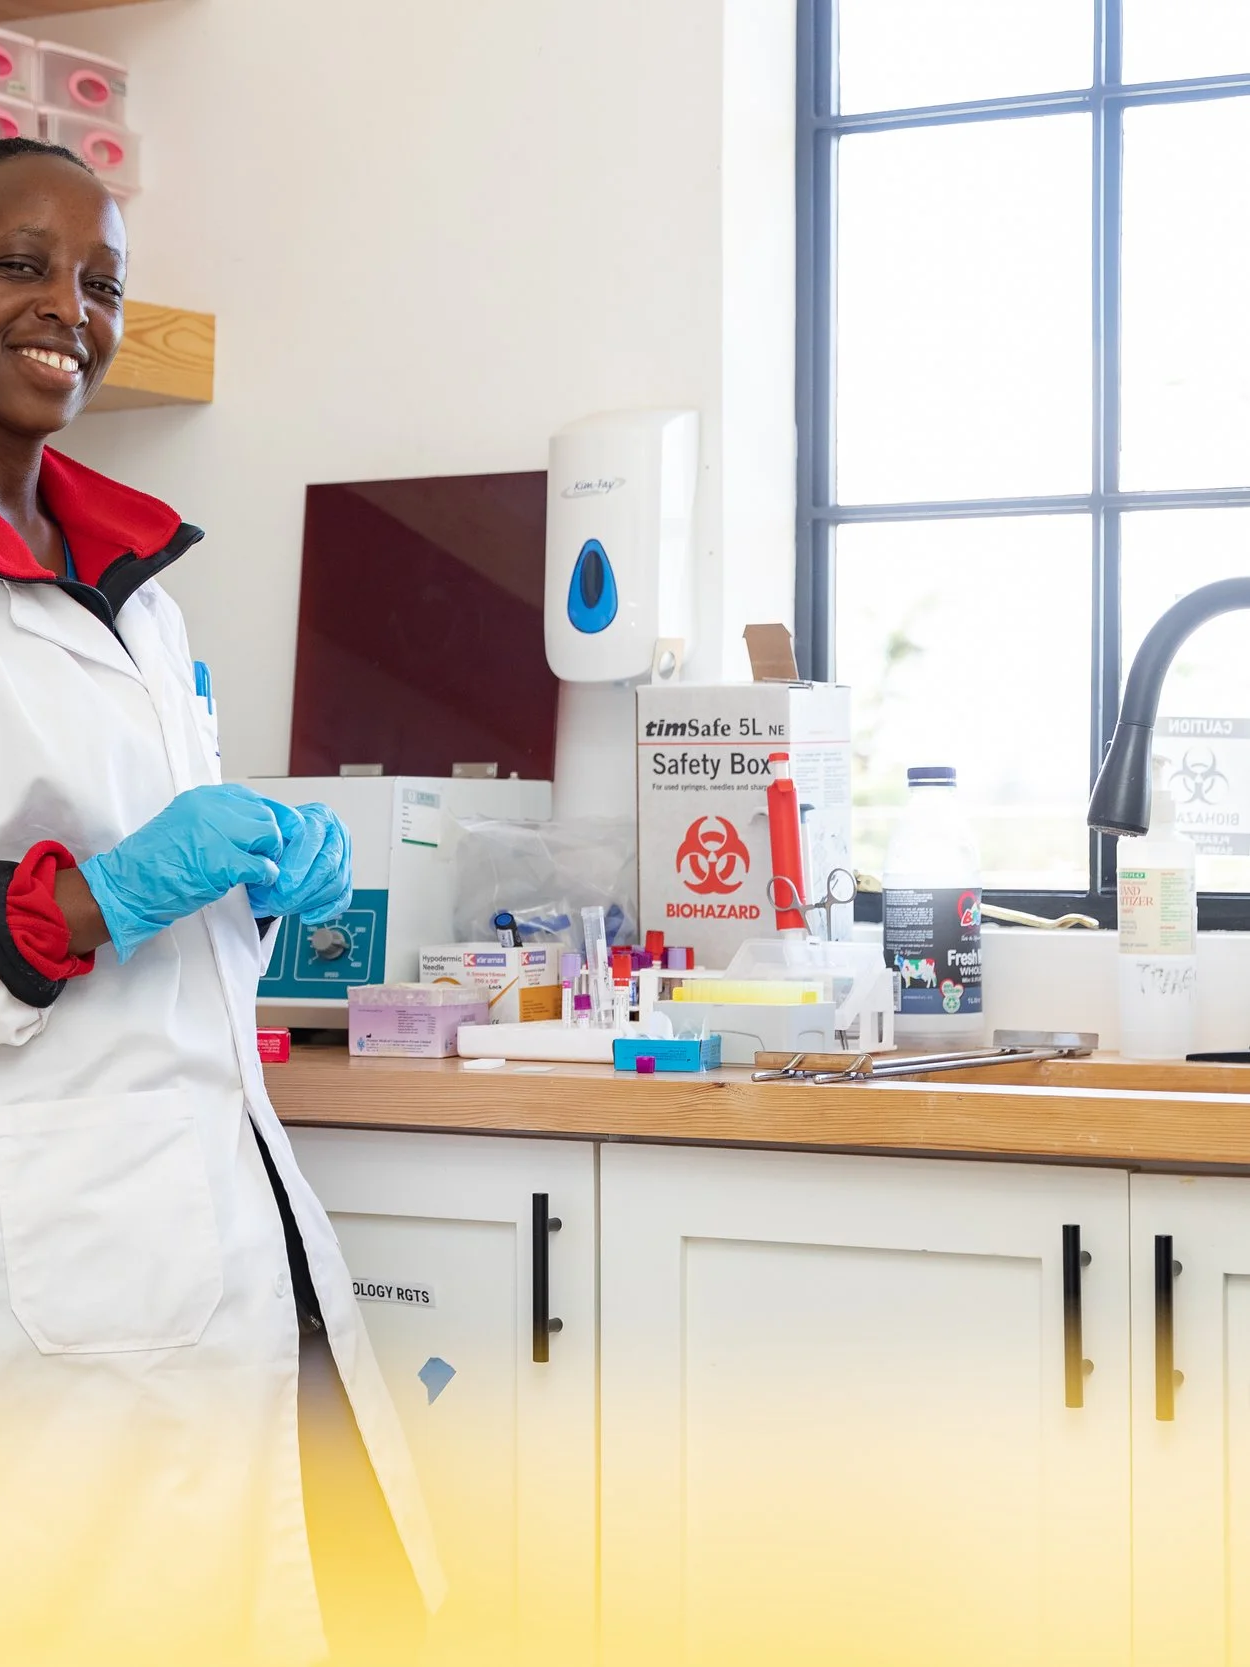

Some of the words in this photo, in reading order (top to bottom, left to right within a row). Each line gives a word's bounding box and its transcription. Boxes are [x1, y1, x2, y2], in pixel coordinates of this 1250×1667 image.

[645, 718, 731, 737] timSafe
[739, 718, 762, 736] 5L
[769, 724, 785, 736] NE
[653, 752, 721, 780] Safety
[730, 753, 771, 775] Box
[666, 903, 761, 919] BIOHAZARD
[422, 955, 462, 964] Hypodermic
[947, 949, 977, 967] Fresh
[352, 1282, 393, 1299] OLOGY
[396, 1287, 430, 1303] RGTS
